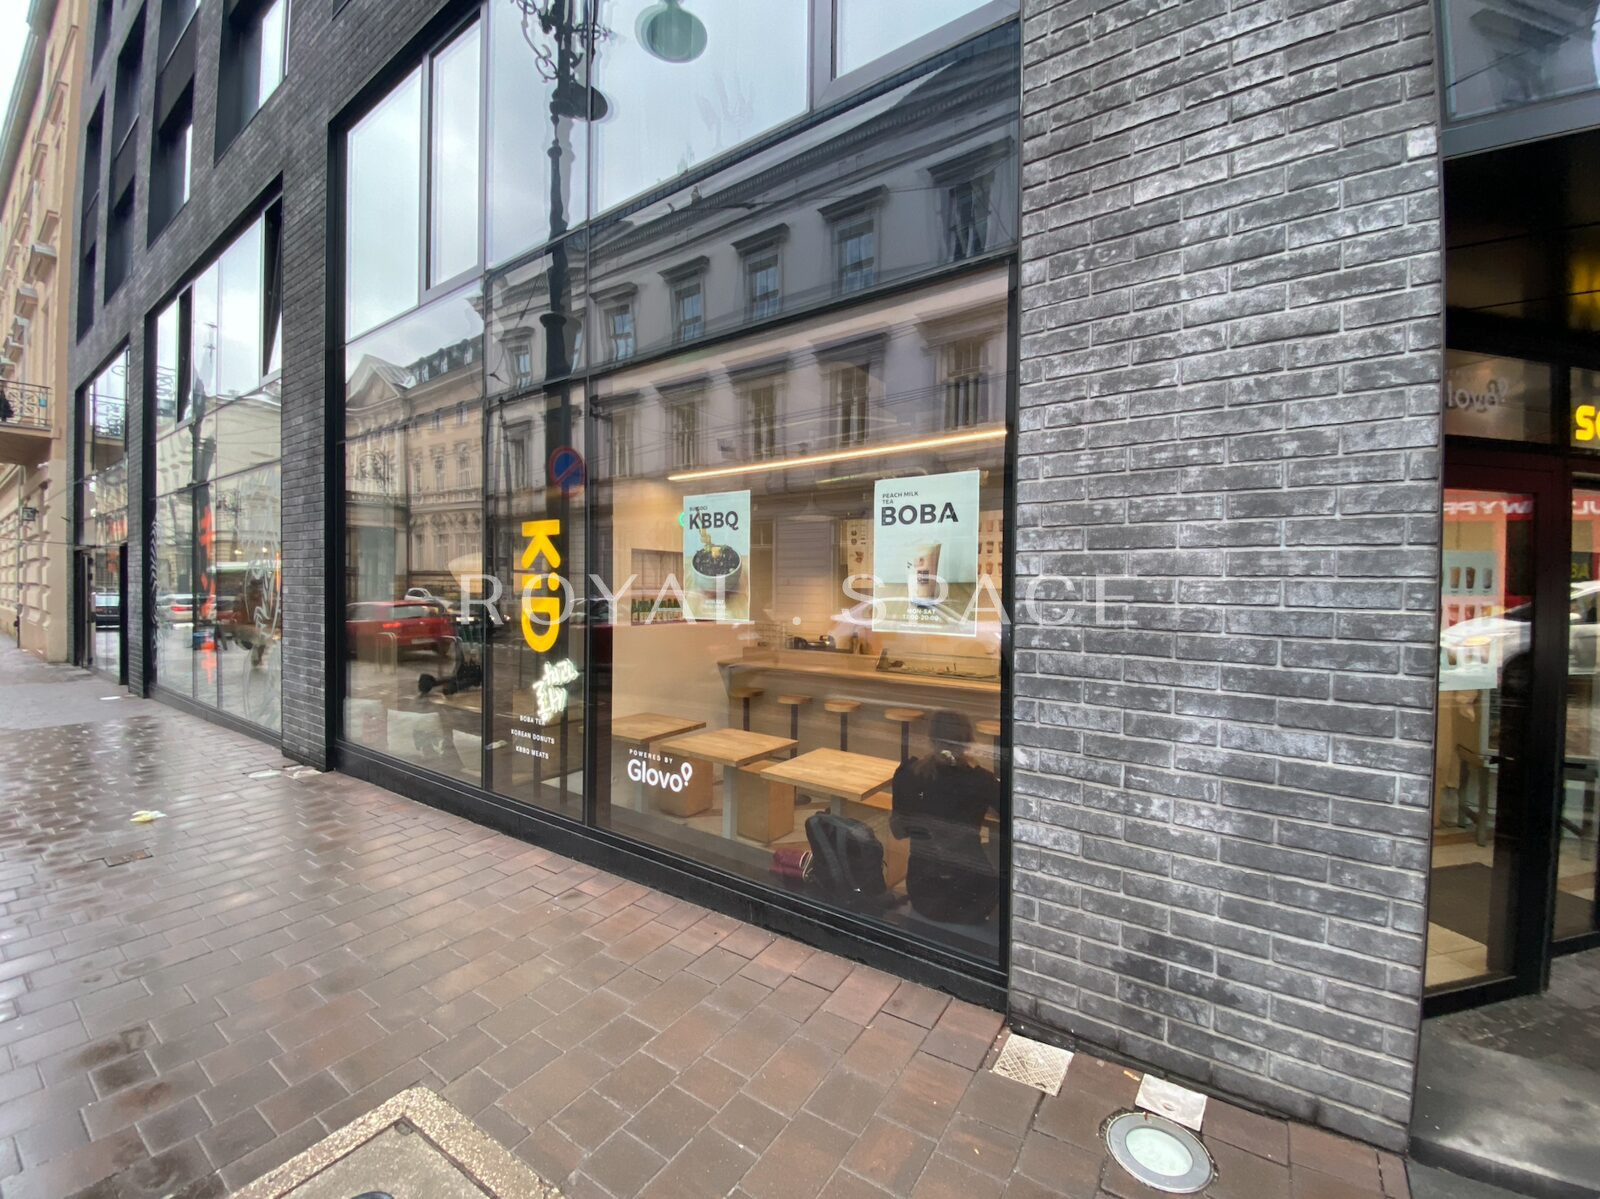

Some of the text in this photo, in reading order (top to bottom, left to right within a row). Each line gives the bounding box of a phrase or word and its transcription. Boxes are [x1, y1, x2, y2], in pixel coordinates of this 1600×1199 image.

[689, 511, 739, 531] KBBQ
[881, 502, 959, 526] BOBA
[511, 728, 555, 745] KOREAN DONUTS
[515, 745, 549, 759] KBBQ MEATS
[628, 748, 673, 764] POWERED BY
[627, 758, 684, 793] Glovo
